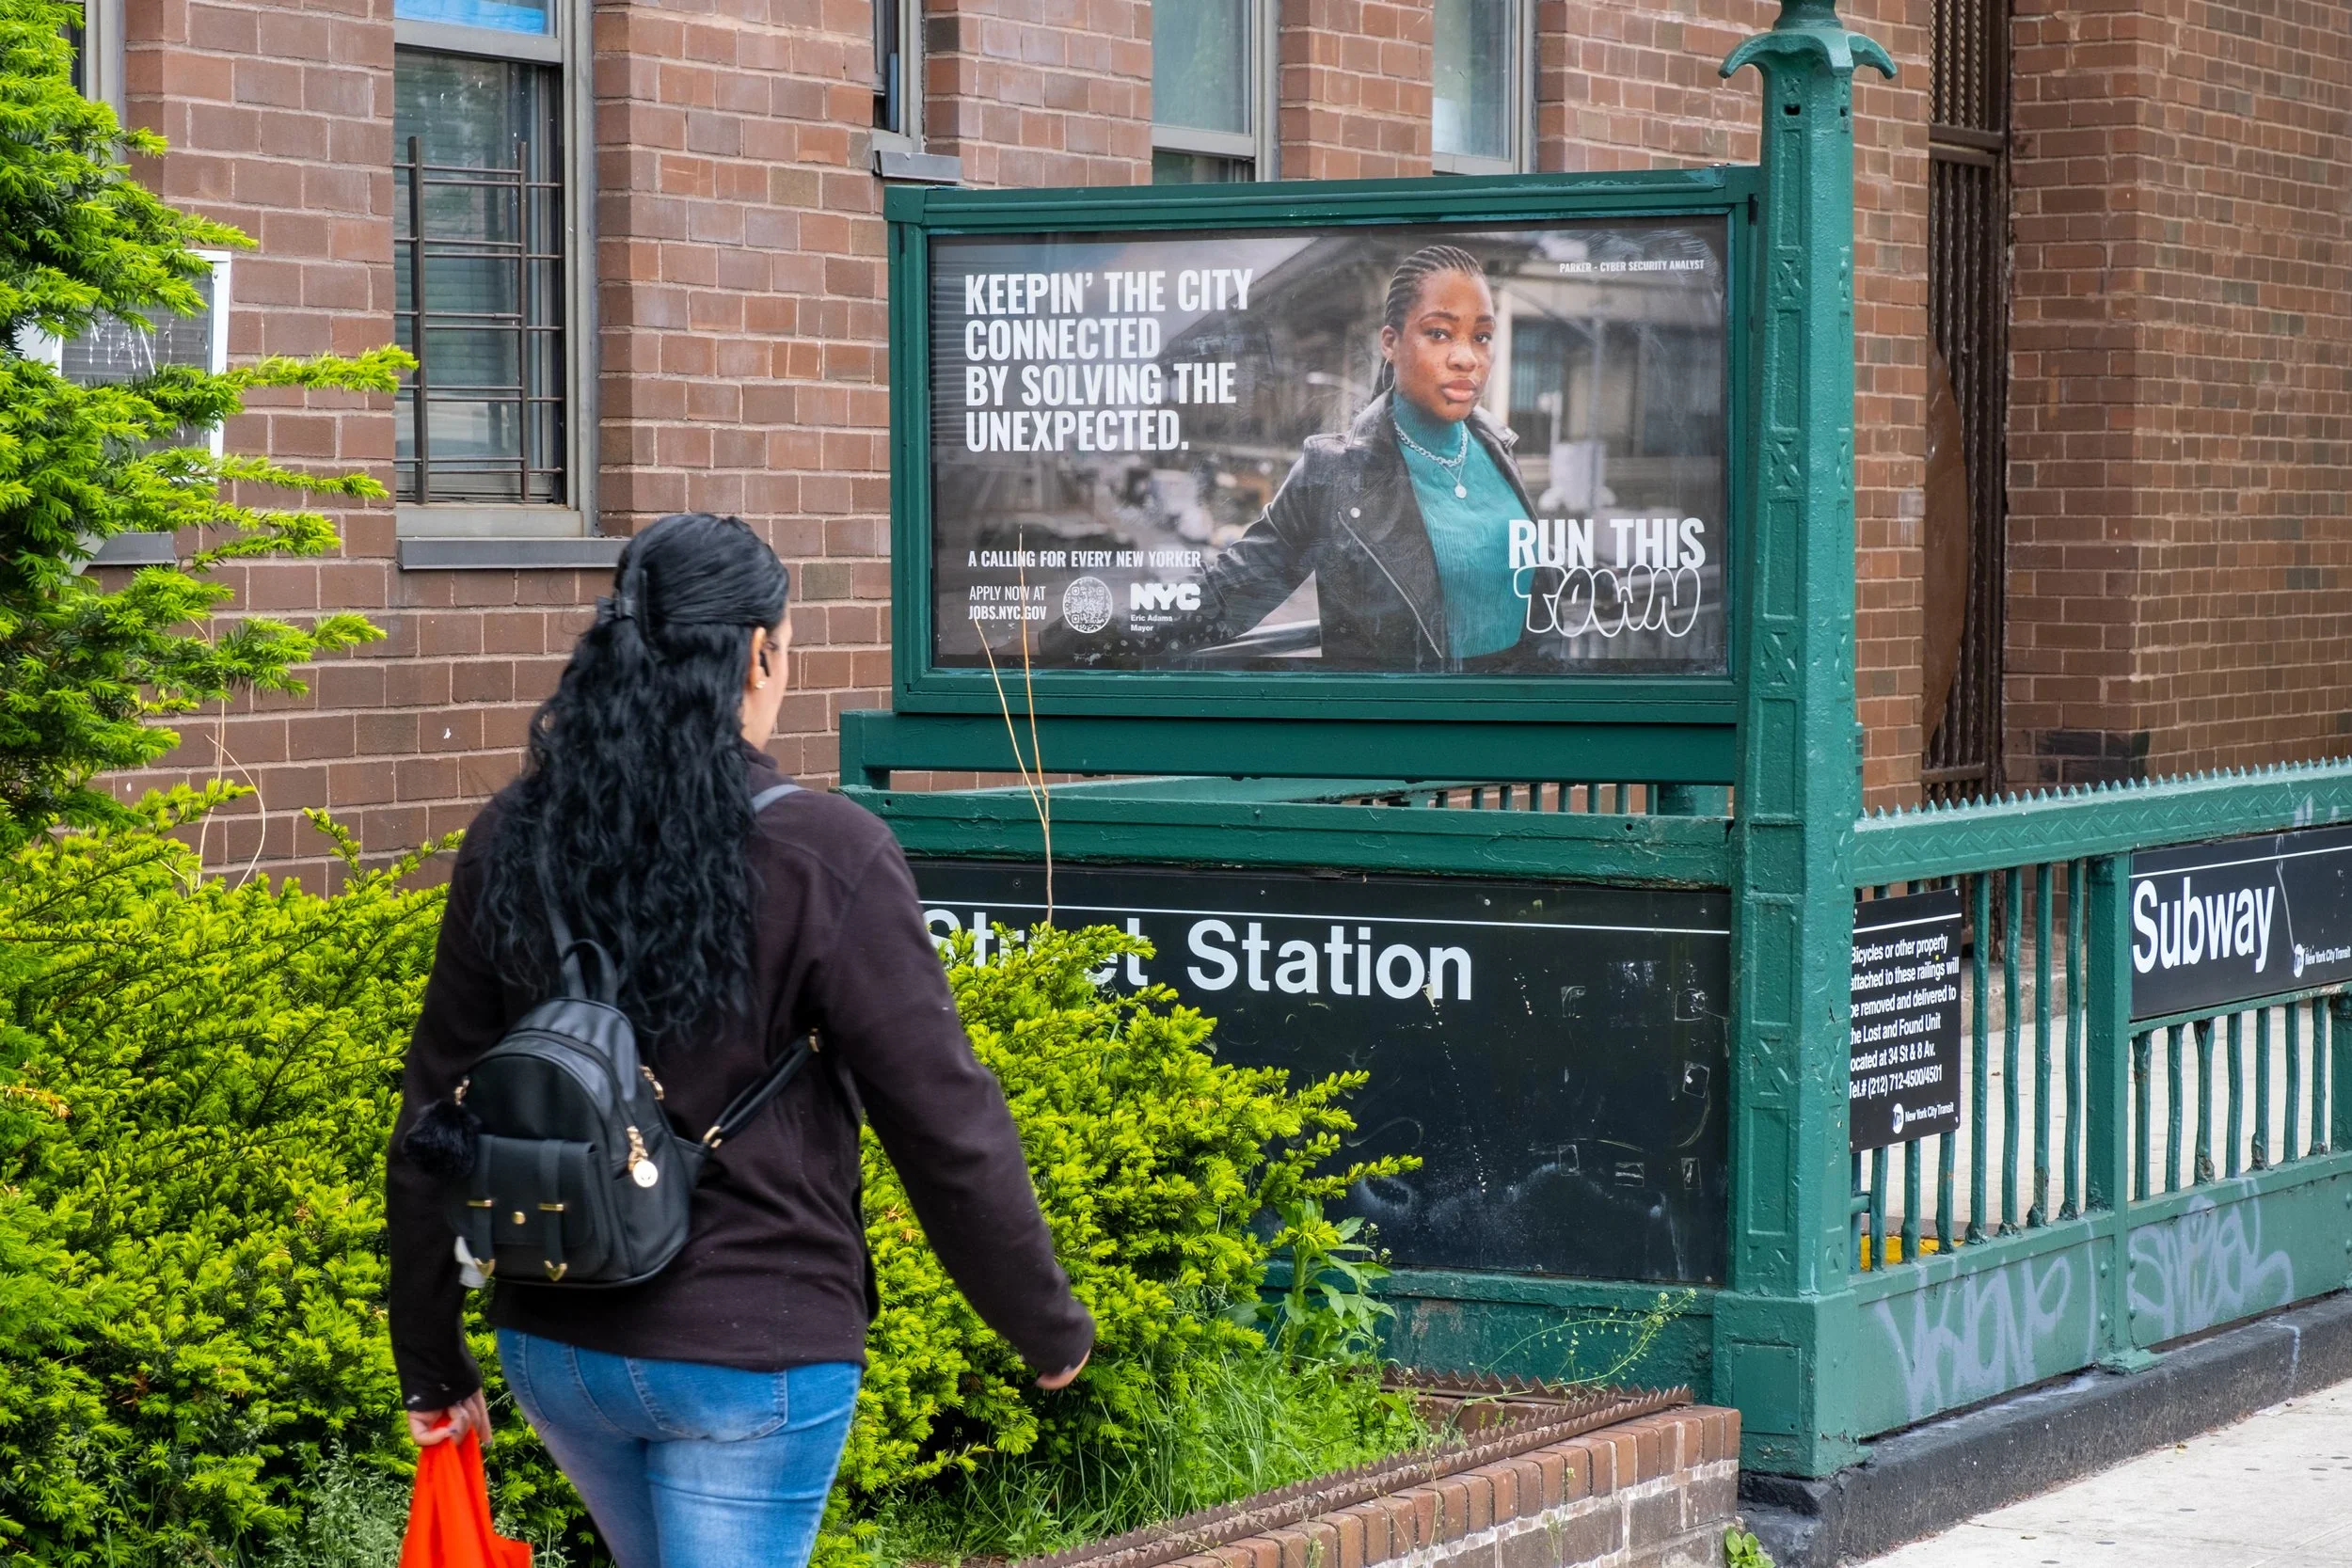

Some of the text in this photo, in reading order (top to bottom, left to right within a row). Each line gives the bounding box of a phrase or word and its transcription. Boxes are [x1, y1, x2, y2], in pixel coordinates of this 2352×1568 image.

[1560, 263, 1592, 273] PARKER
[1599, 261, 1626, 272] CYBER
[1629, 260, 1667, 271] SECURITY
[1669, 260, 1705, 270] ANALYST
[965, 269, 1253, 315] KEEPIN' THE CITY
[965, 318, 1161, 361] CONNECTED
[966, 362, 1236, 406] BY SOLVING THE
[965, 410, 1189, 451] UNEXPECTED.
[967, 550, 1200, 567] A CALLING FOR EVERY NEW YORKER
[1509, 517, 1706, 569] RUN THIS
[969, 585, 1046, 600] APPLY NOW AT
[1131, 583, 1200, 610] NYC
[1513, 564, 1701, 638] TOWN
[969, 606, 1046, 621] JOBS.NYC.GOV
[1131, 614, 1146, 623] Eric
[2132, 877, 2275, 974] Subway
[1186, 918, 1472, 1001] Station
[1851, 933, 1947, 967] Bicycles or other property
[1885, 969, 1893, 986] to
[1895, 966, 1915, 984] these
[1917, 961, 1946, 981] railings
[1946, 956, 1959, 974] will
[1861, 993, 1895, 1016] removed
[1897, 991, 1912, 1010] and
[1913, 984, 1947, 1006] delivered
[1948, 984, 1957, 1001] to
[1863, 1023, 1882, 1042] Lost
[1883, 1020, 1898, 1038] and
[1899, 1015, 1923, 1037] Found
[1925, 1012, 1942, 1031] Unit
[1850, 1040, 1936, 1072] ocated at 34 St & 8 Av.
[1868, 1074, 1887, 1100] (212)
[1889, 1064, 1942, 1091] 712-4500/4501
[1904, 1111, 1915, 1123] New
[1916, 1108, 1927, 1119] York
[1927, 1106, 1938, 1119] City
[1937, 1102, 1954, 1116] Transit
